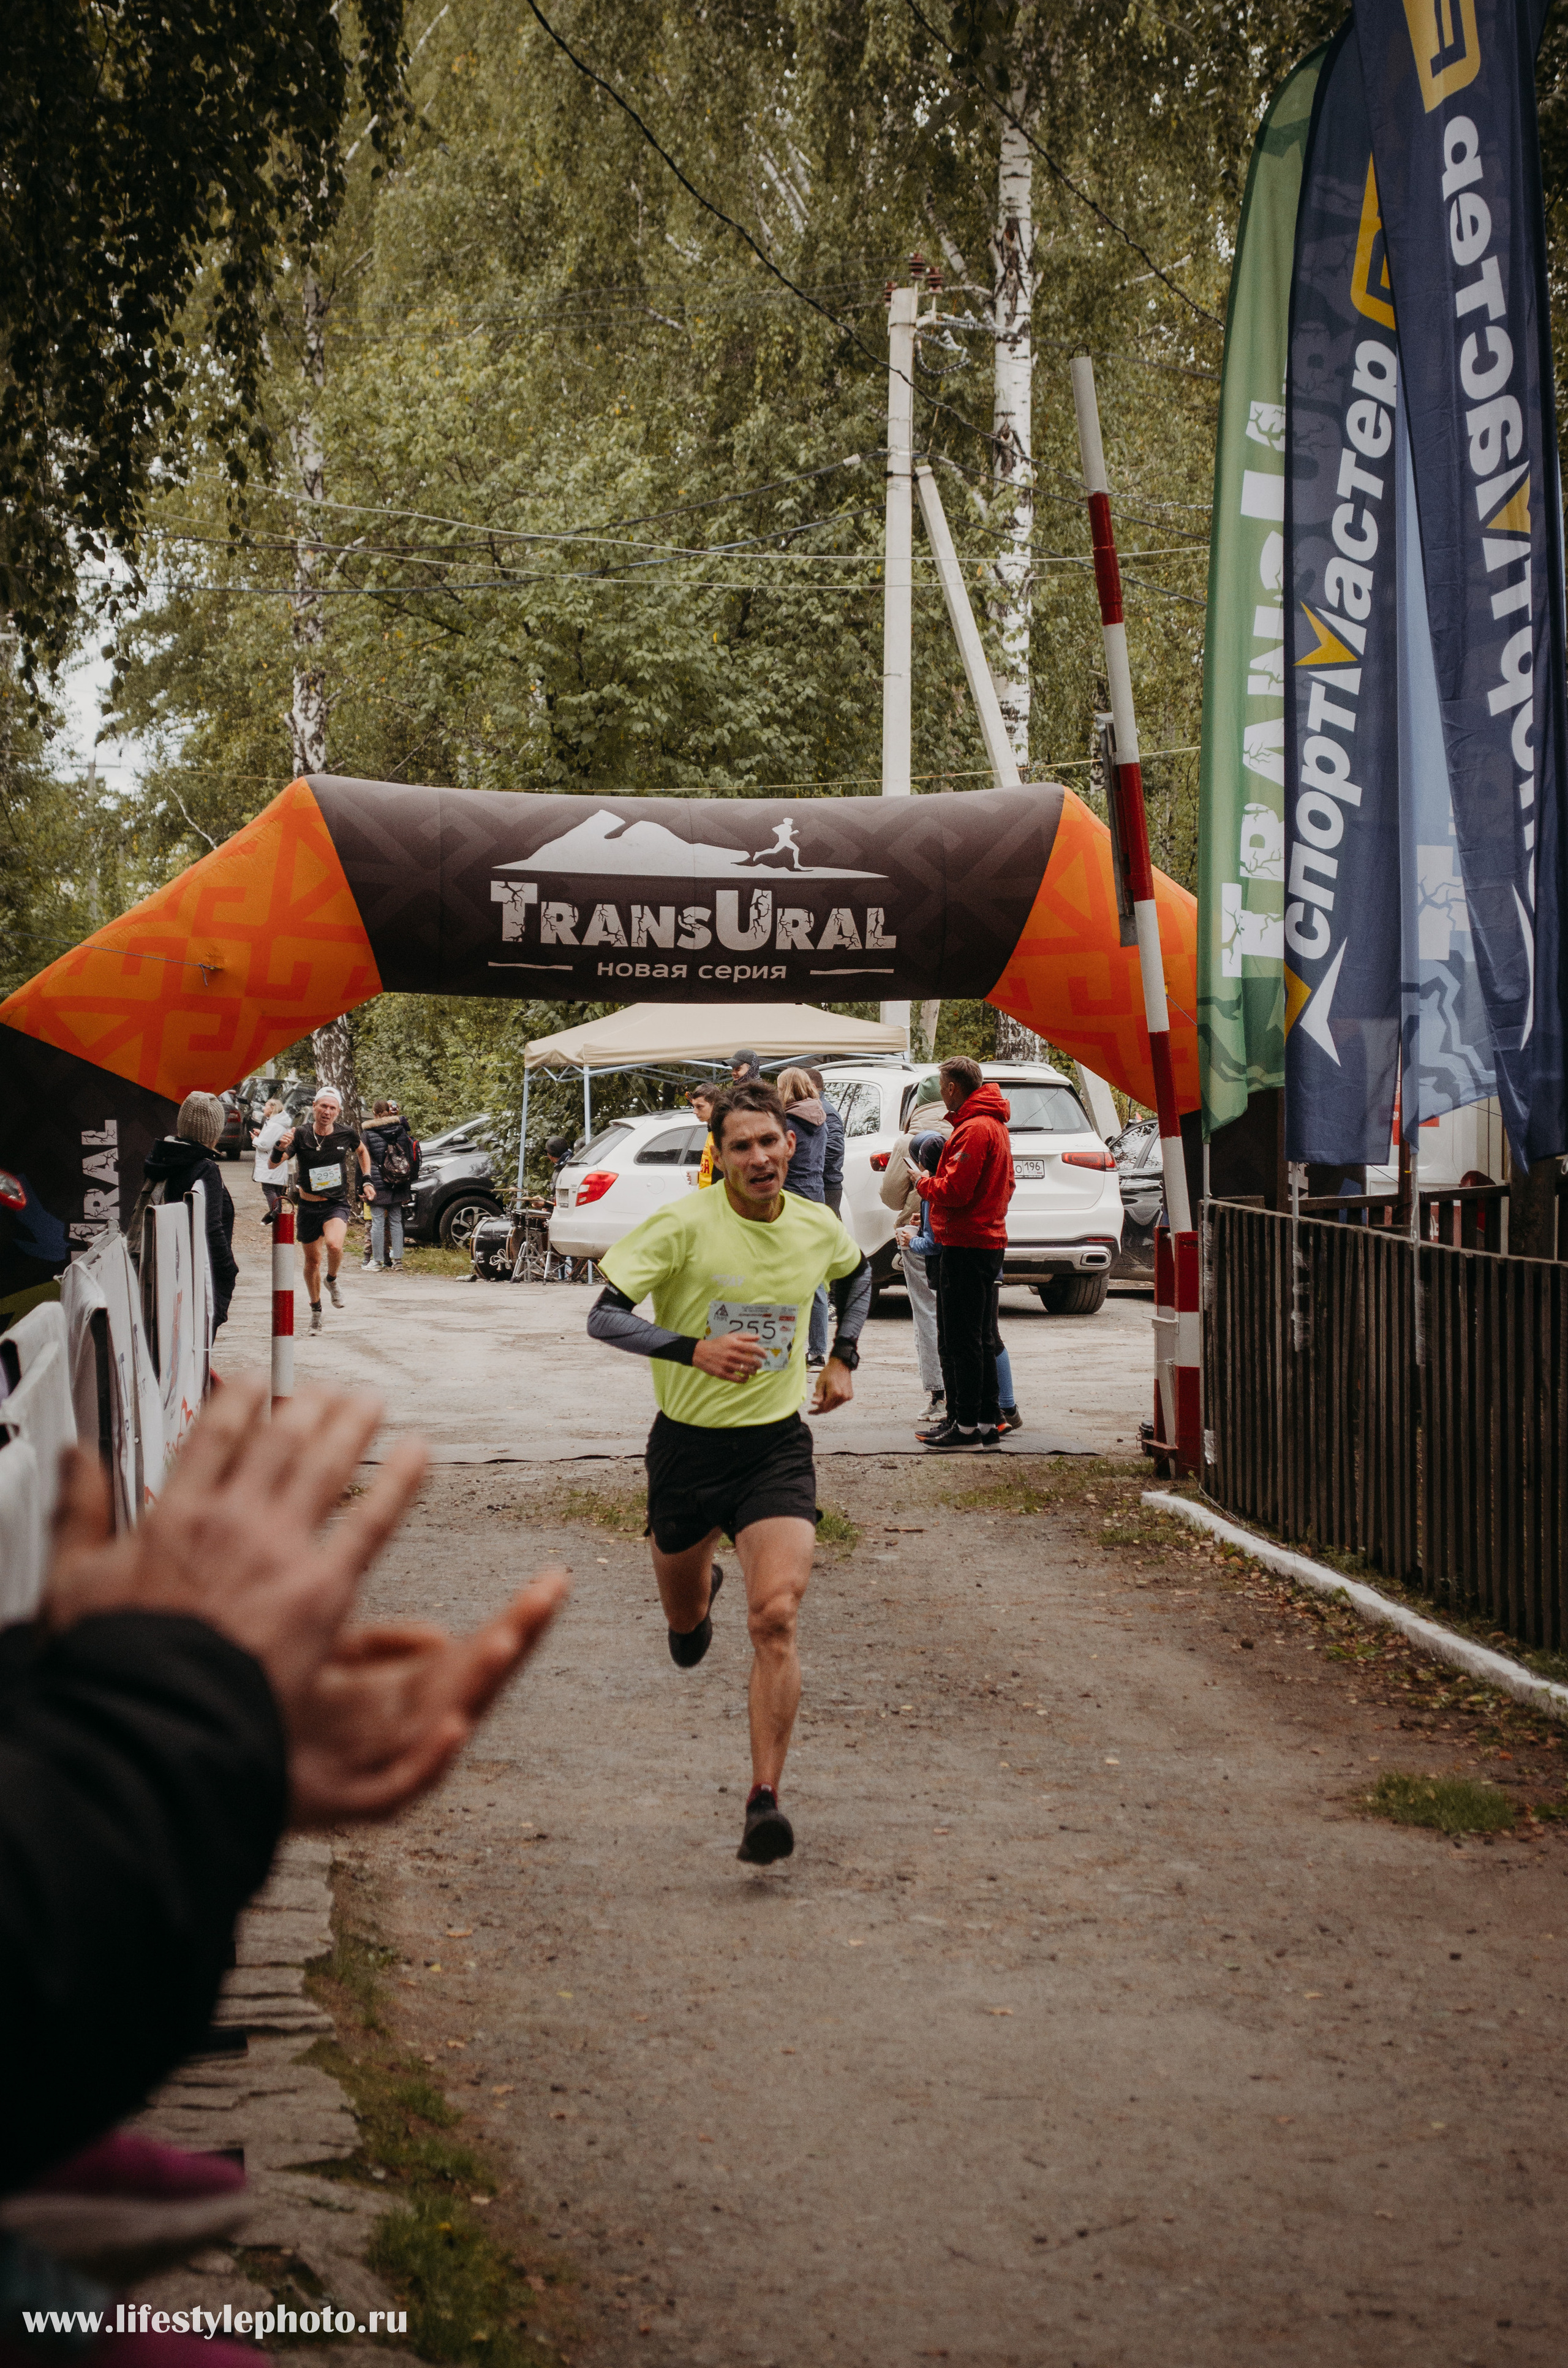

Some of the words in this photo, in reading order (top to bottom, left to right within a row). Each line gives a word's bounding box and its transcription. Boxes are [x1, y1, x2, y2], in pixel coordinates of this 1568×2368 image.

[597, 961, 687, 978] новая
[698, 963, 787, 983] серия
[1024, 1162, 1041, 1171] 196
[317, 1171, 334, 1181] 295
[728, 1319, 776, 1340] 255
